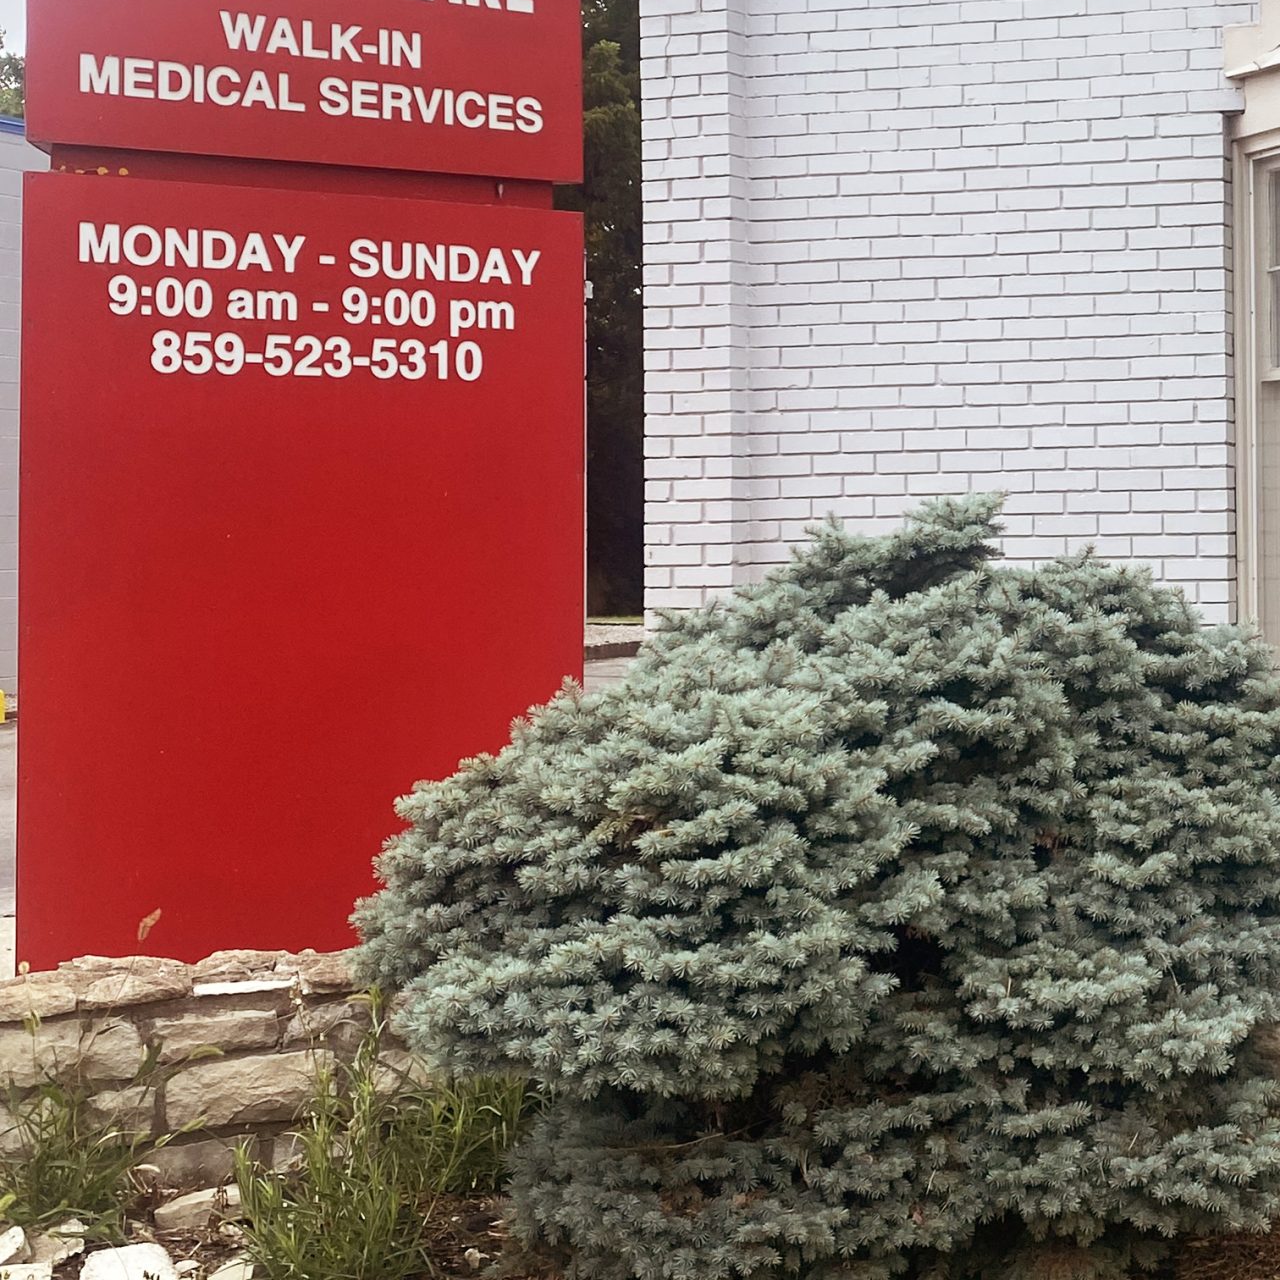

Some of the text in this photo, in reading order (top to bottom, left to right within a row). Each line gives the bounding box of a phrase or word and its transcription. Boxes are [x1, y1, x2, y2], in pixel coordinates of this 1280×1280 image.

[219, 11, 421, 68] WALK-IN
[79, 53, 543, 133] MEDICAL SERVICES
[79, 222, 541, 285] MONDAY - SUNDAY
[108, 275, 515, 337] 9:00 am - 9:00 pm
[151, 330, 483, 381] 859-523-5310
